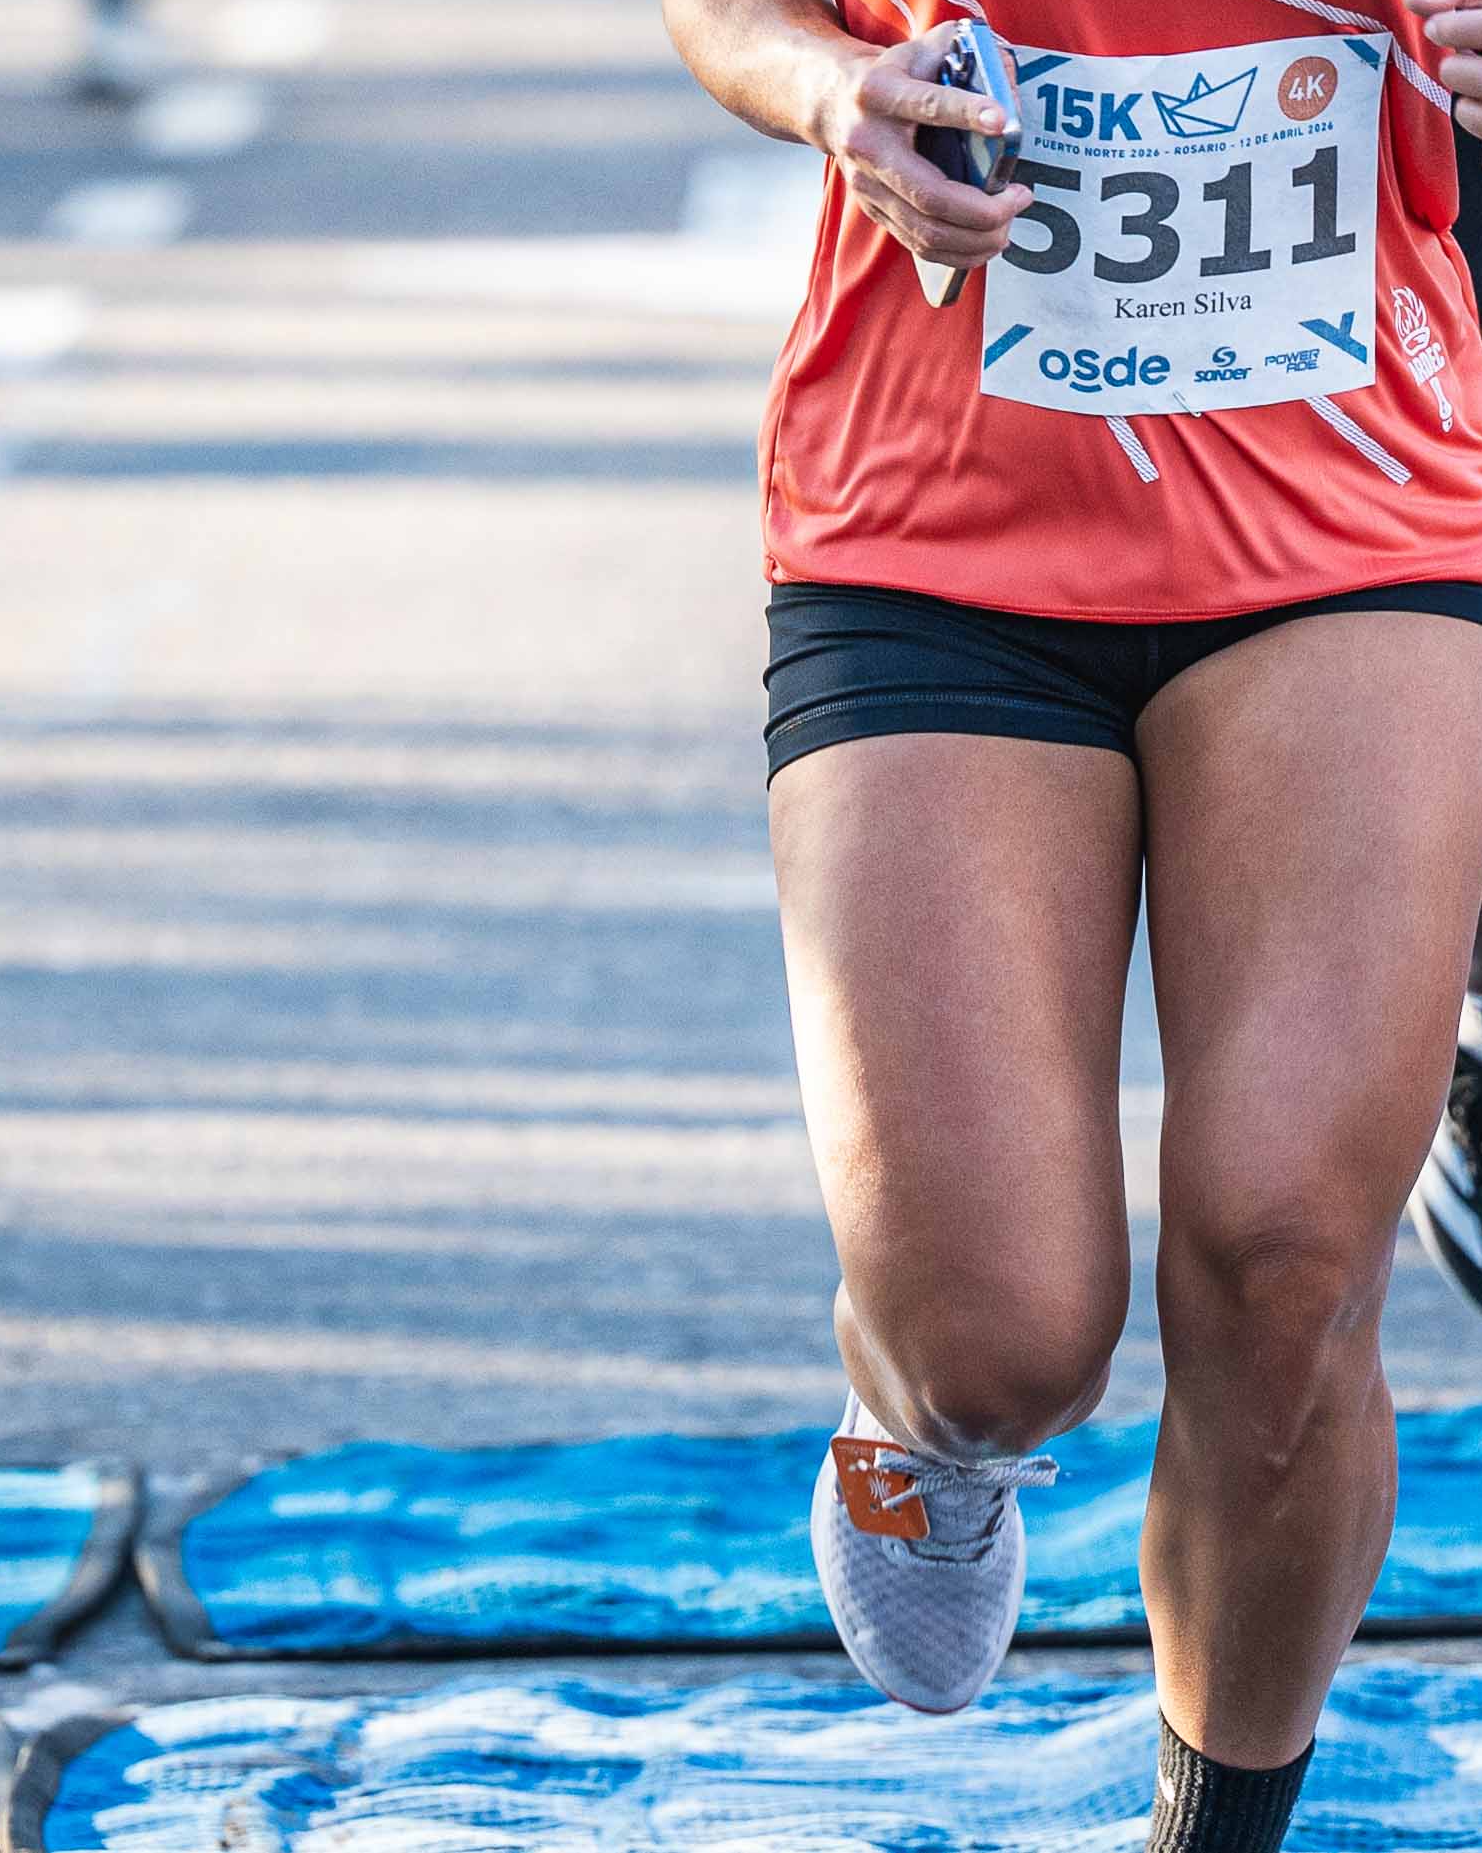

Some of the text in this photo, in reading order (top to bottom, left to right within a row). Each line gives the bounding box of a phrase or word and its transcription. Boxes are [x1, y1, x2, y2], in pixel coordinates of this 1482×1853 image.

[1287, 73, 1326, 101] 4K
[1037, 82, 1143, 141] 15K
[1034, 136, 1080, 155] PUERTO
[1084, 147, 1126, 158] NORTE
[1129, 148, 1160, 158] 2026
[1174, 142, 1227, 155] ROSARIO
[1239, 138, 1251, 148] 12
[1255, 133, 1269, 146] DE
[1272, 128, 1304, 142] ABRIL
[1307, 121, 1334, 135] 2026
[1001, 145, 1356, 284] 5311
[1114, 293, 1252, 319] Karen Silva
[1038, 346, 1171, 390] osde
[1264, 348, 1320, 367] POWER
